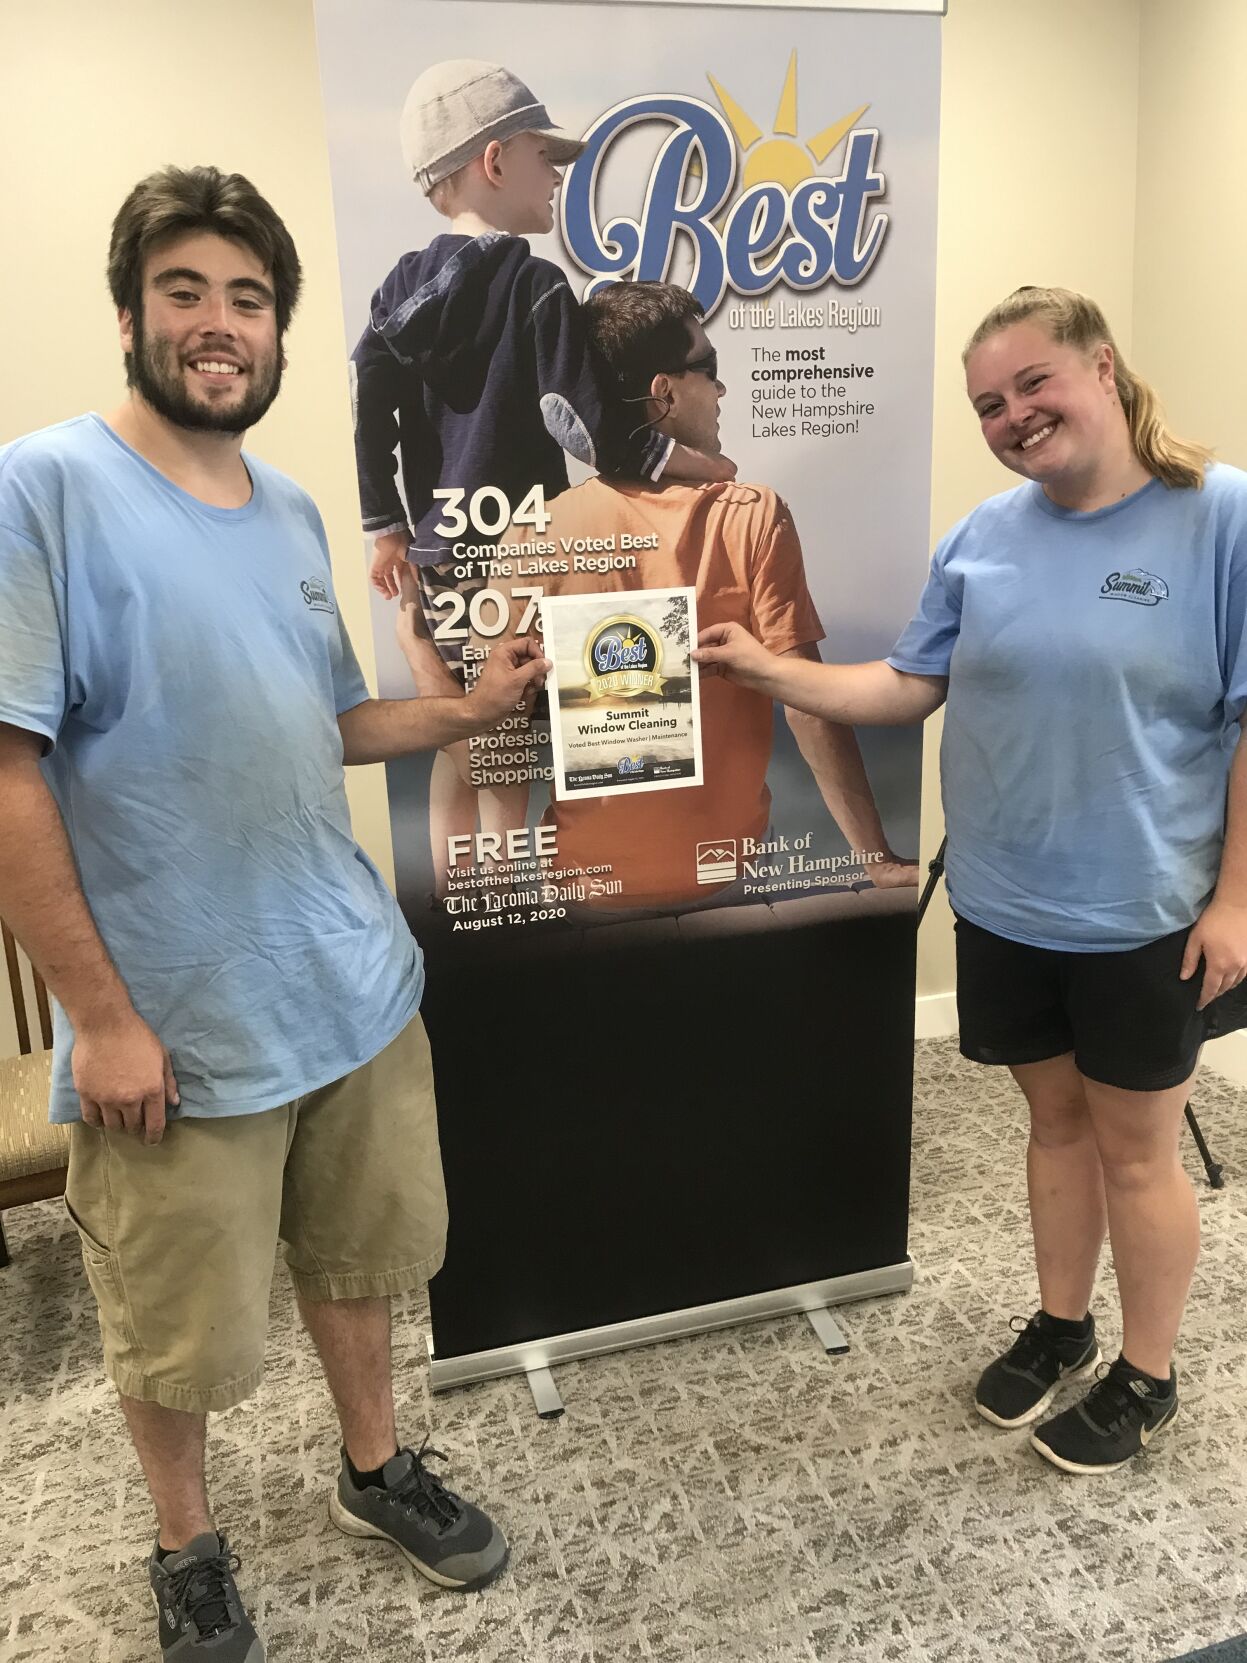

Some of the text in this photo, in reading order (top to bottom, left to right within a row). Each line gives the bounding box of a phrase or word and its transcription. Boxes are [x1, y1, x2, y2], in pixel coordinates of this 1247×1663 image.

[560, 93, 888, 326] Best
[729, 299, 880, 333] of the Lakes Region
[751, 347, 825, 362] The most
[751, 364, 874, 382] comprehensive
[752, 383, 846, 403] guide to the
[752, 401, 875, 419] New Hampshire
[752, 420, 859, 438] Lakes Region!
[432, 484, 551, 538] 304
[452, 532, 659, 559] Companies Voted Best
[454, 554, 636, 579] of The Lakes Region
[1101, 572, 1151, 596] Summit
[432, 586, 544, 640] 207
[595, 636, 647, 671] Best
[621, 674, 654, 687] WINNER
[578, 718, 677, 735] Window Cleaning
[606, 708, 649, 721] Summit
[469, 730, 553, 751] Professio
[569, 741, 586, 749] Voted
[652, 732, 688, 740] Maintenance
[470, 748, 539, 768] Schools
[471, 765, 555, 785] Shopping
[447, 824, 559, 866] FREE
[741, 831, 813, 857] Bank of
[447, 858, 554, 879] Visit us online at
[742, 849, 884, 880] New Hampshire
[447, 863, 612, 891] bestofthelakesregion.com
[744, 871, 864, 895] Presenting Sponsor
[443, 878, 623, 914] The Laconia Daily Sun
[453, 907, 567, 931] August 12, 2020
